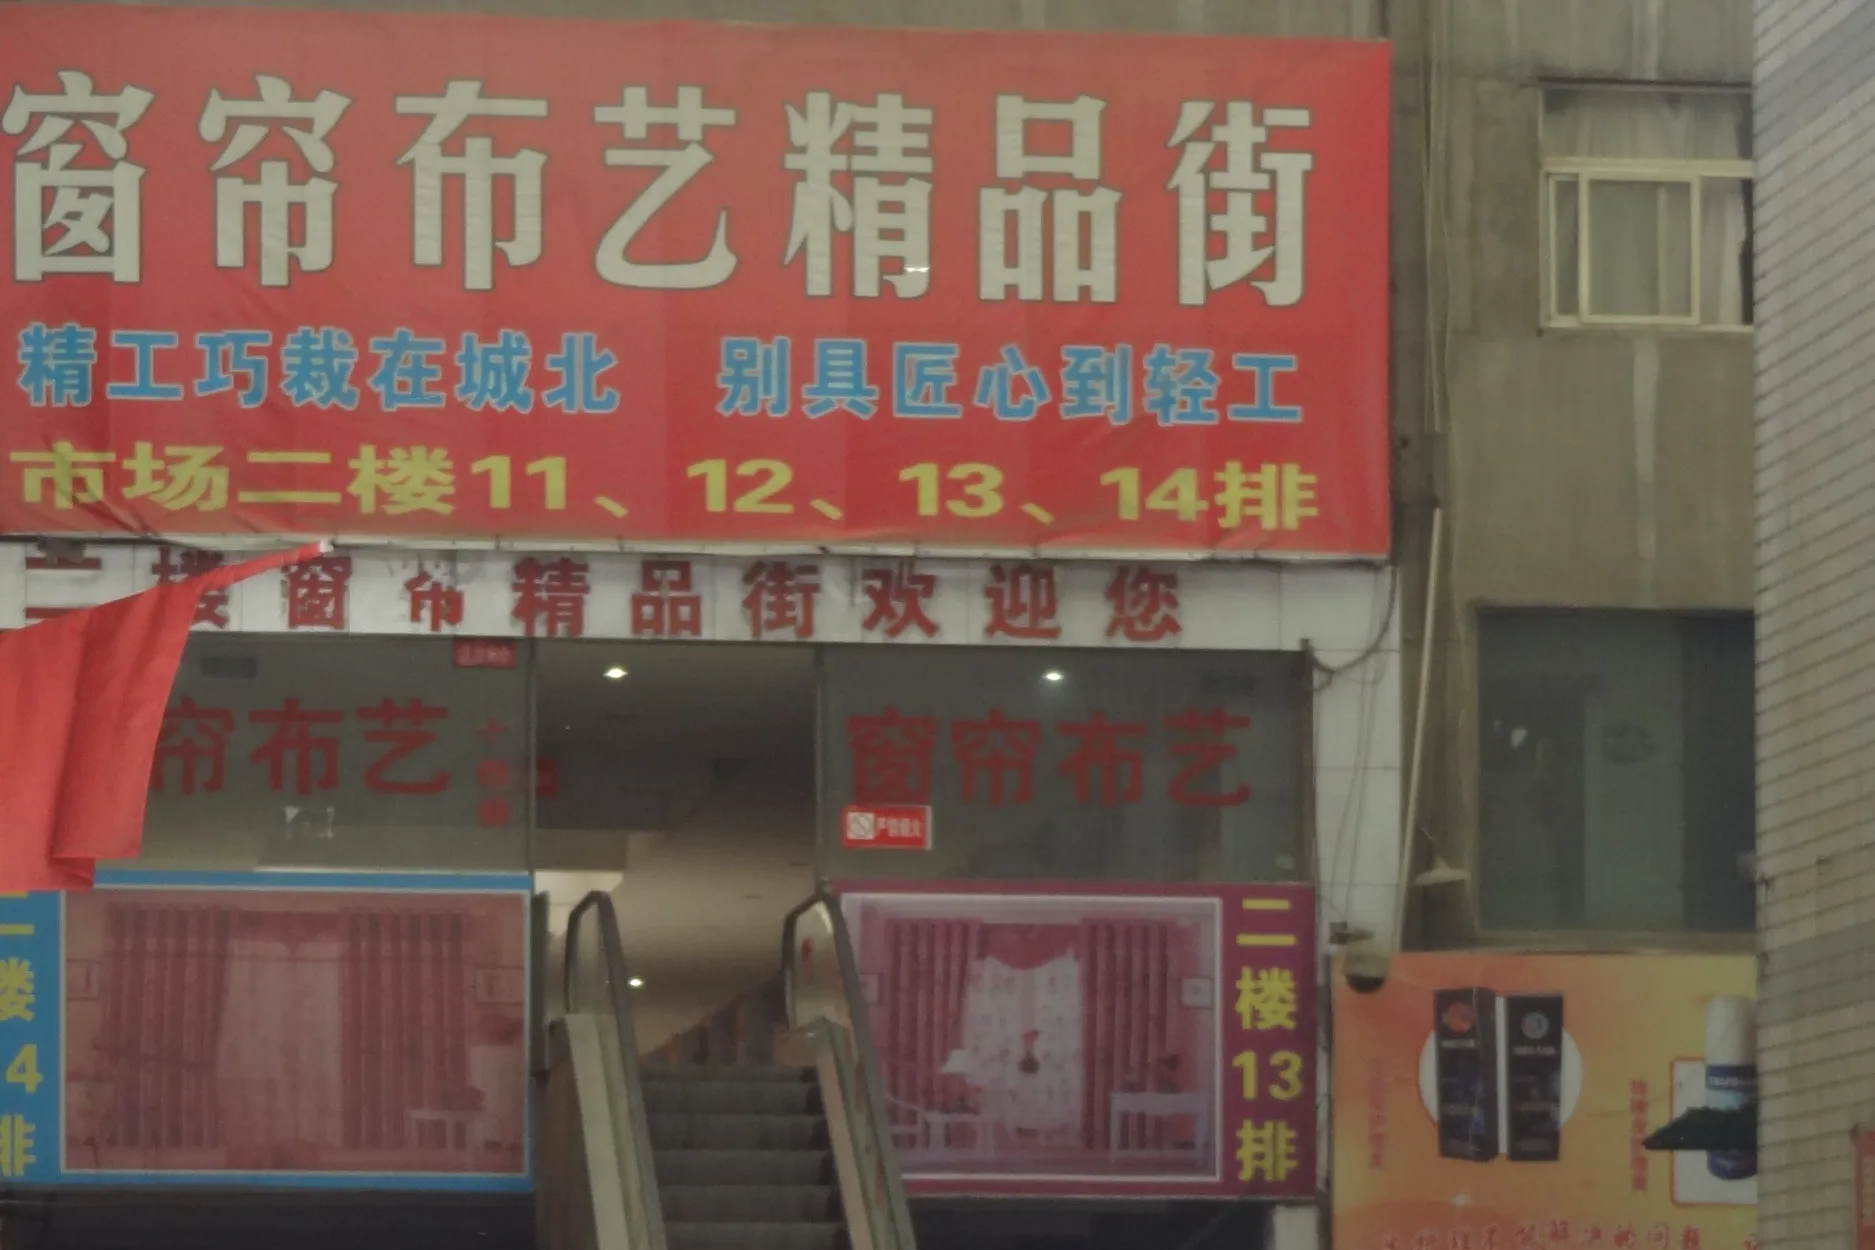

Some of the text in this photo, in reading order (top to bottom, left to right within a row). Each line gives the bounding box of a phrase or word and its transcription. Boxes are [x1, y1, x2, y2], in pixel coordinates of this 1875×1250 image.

[2, 70, 1314, 306] 窗帘布艺精品街
[17, 322, 1303, 426] 精工巧裁在城北 别具匠心到轻工
[9, 441, 1319, 531] 市场二楼11、12、13、14排
[844, 705, 1252, 808] 窗帘布艺
[1233, 898, 1302, 1181] 二楼13排
